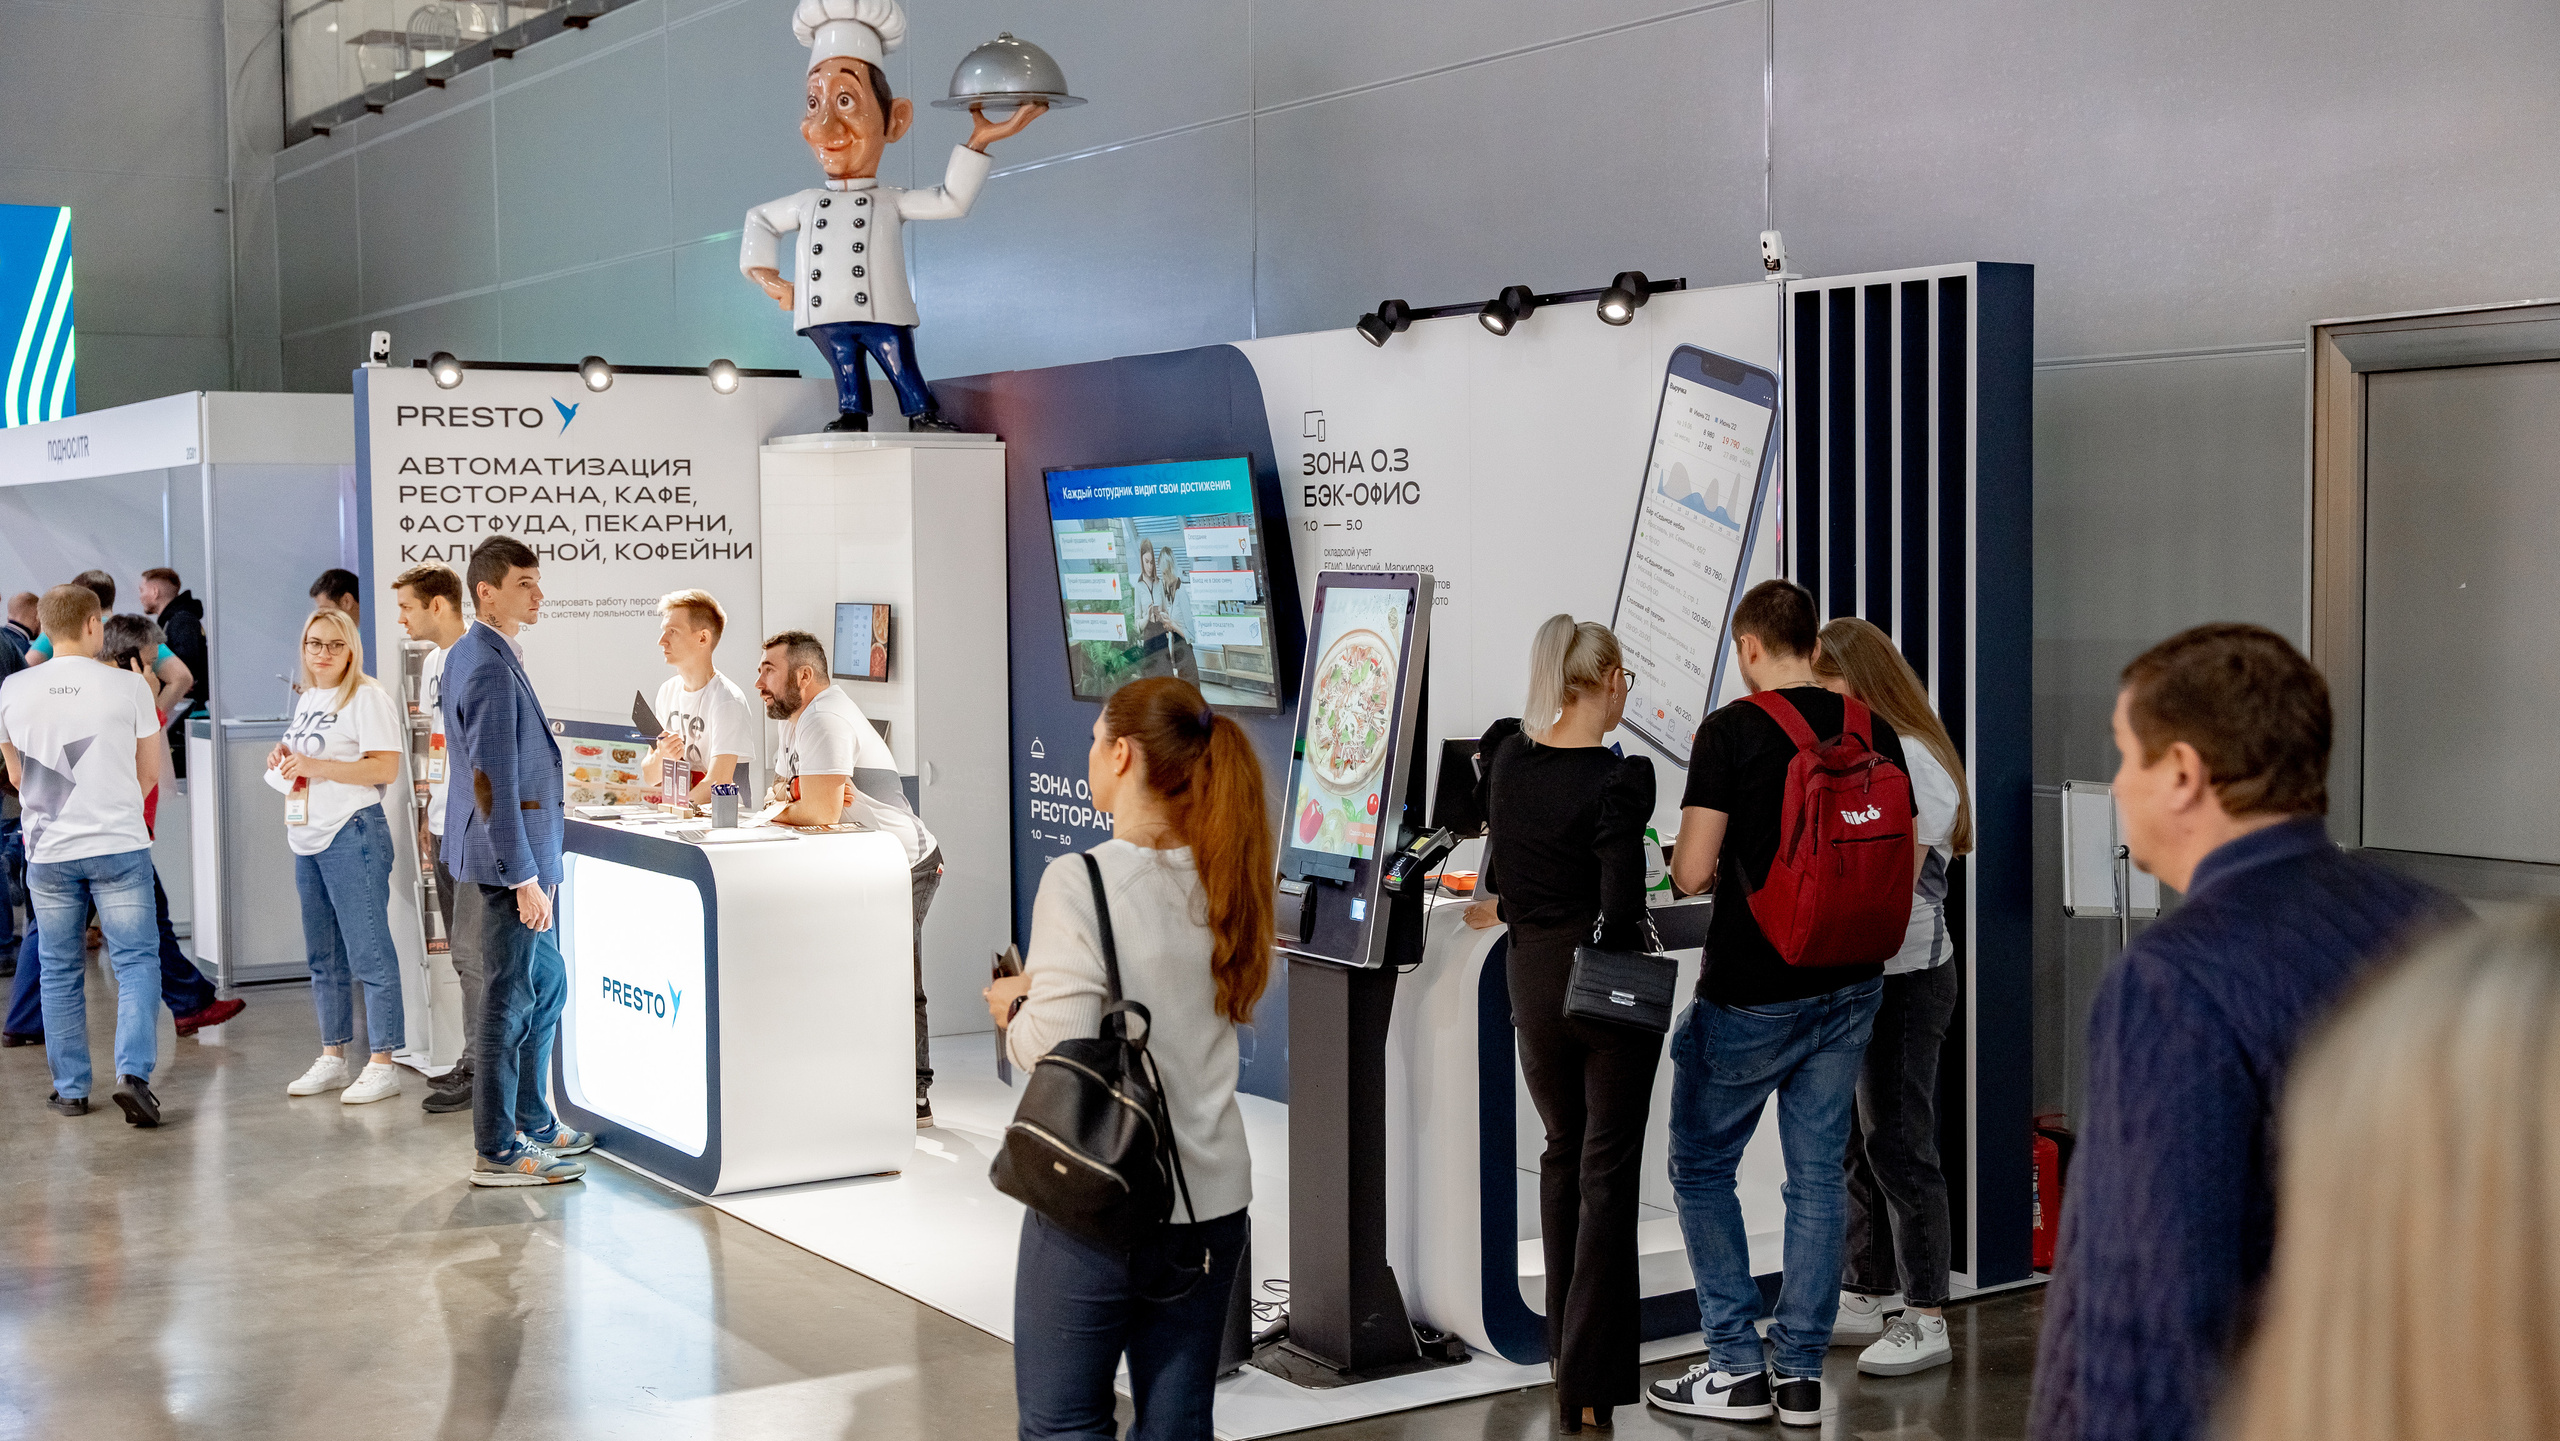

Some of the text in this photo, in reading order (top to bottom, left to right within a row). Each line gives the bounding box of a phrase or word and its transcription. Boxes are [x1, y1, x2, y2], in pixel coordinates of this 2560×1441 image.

[397, 405, 544, 428] PRESTO
[1730, 439, 1740, 449] 790
[398, 457, 692, 478] АВТОМАТИЗАЦИЯ
[1303, 451, 1365, 476] ЗОНА
[399, 486, 698, 507] РЕСТОРАНА, КАФЕ,
[1062, 479, 1231, 500] Каждый сотрудник видит свои достижения
[1304, 481, 1421, 507] БЭК-ОФИС
[400, 514, 733, 536] ФАСТФУДА, ПЕКАРНИ,
[1303, 520, 1318, 531] 1.0
[1346, 519, 1363, 530] 5.0
[401, 538, 753, 565] КАЛНОЙ, КОФЕЙНИ
[1324, 547, 1372, 559] складской учет
[1384, 562, 1434, 573] Маркировка
[539, 597, 660, 608] ролировать работу персо
[551, 611, 590, 620] систему
[593, 609, 645, 618] лояльности
[49, 685, 81, 696] saby
[1029, 772, 1072, 798] ЗОНА
[1840, 804, 1881, 825] iiko
[602, 976, 665, 1019] PRESTO
